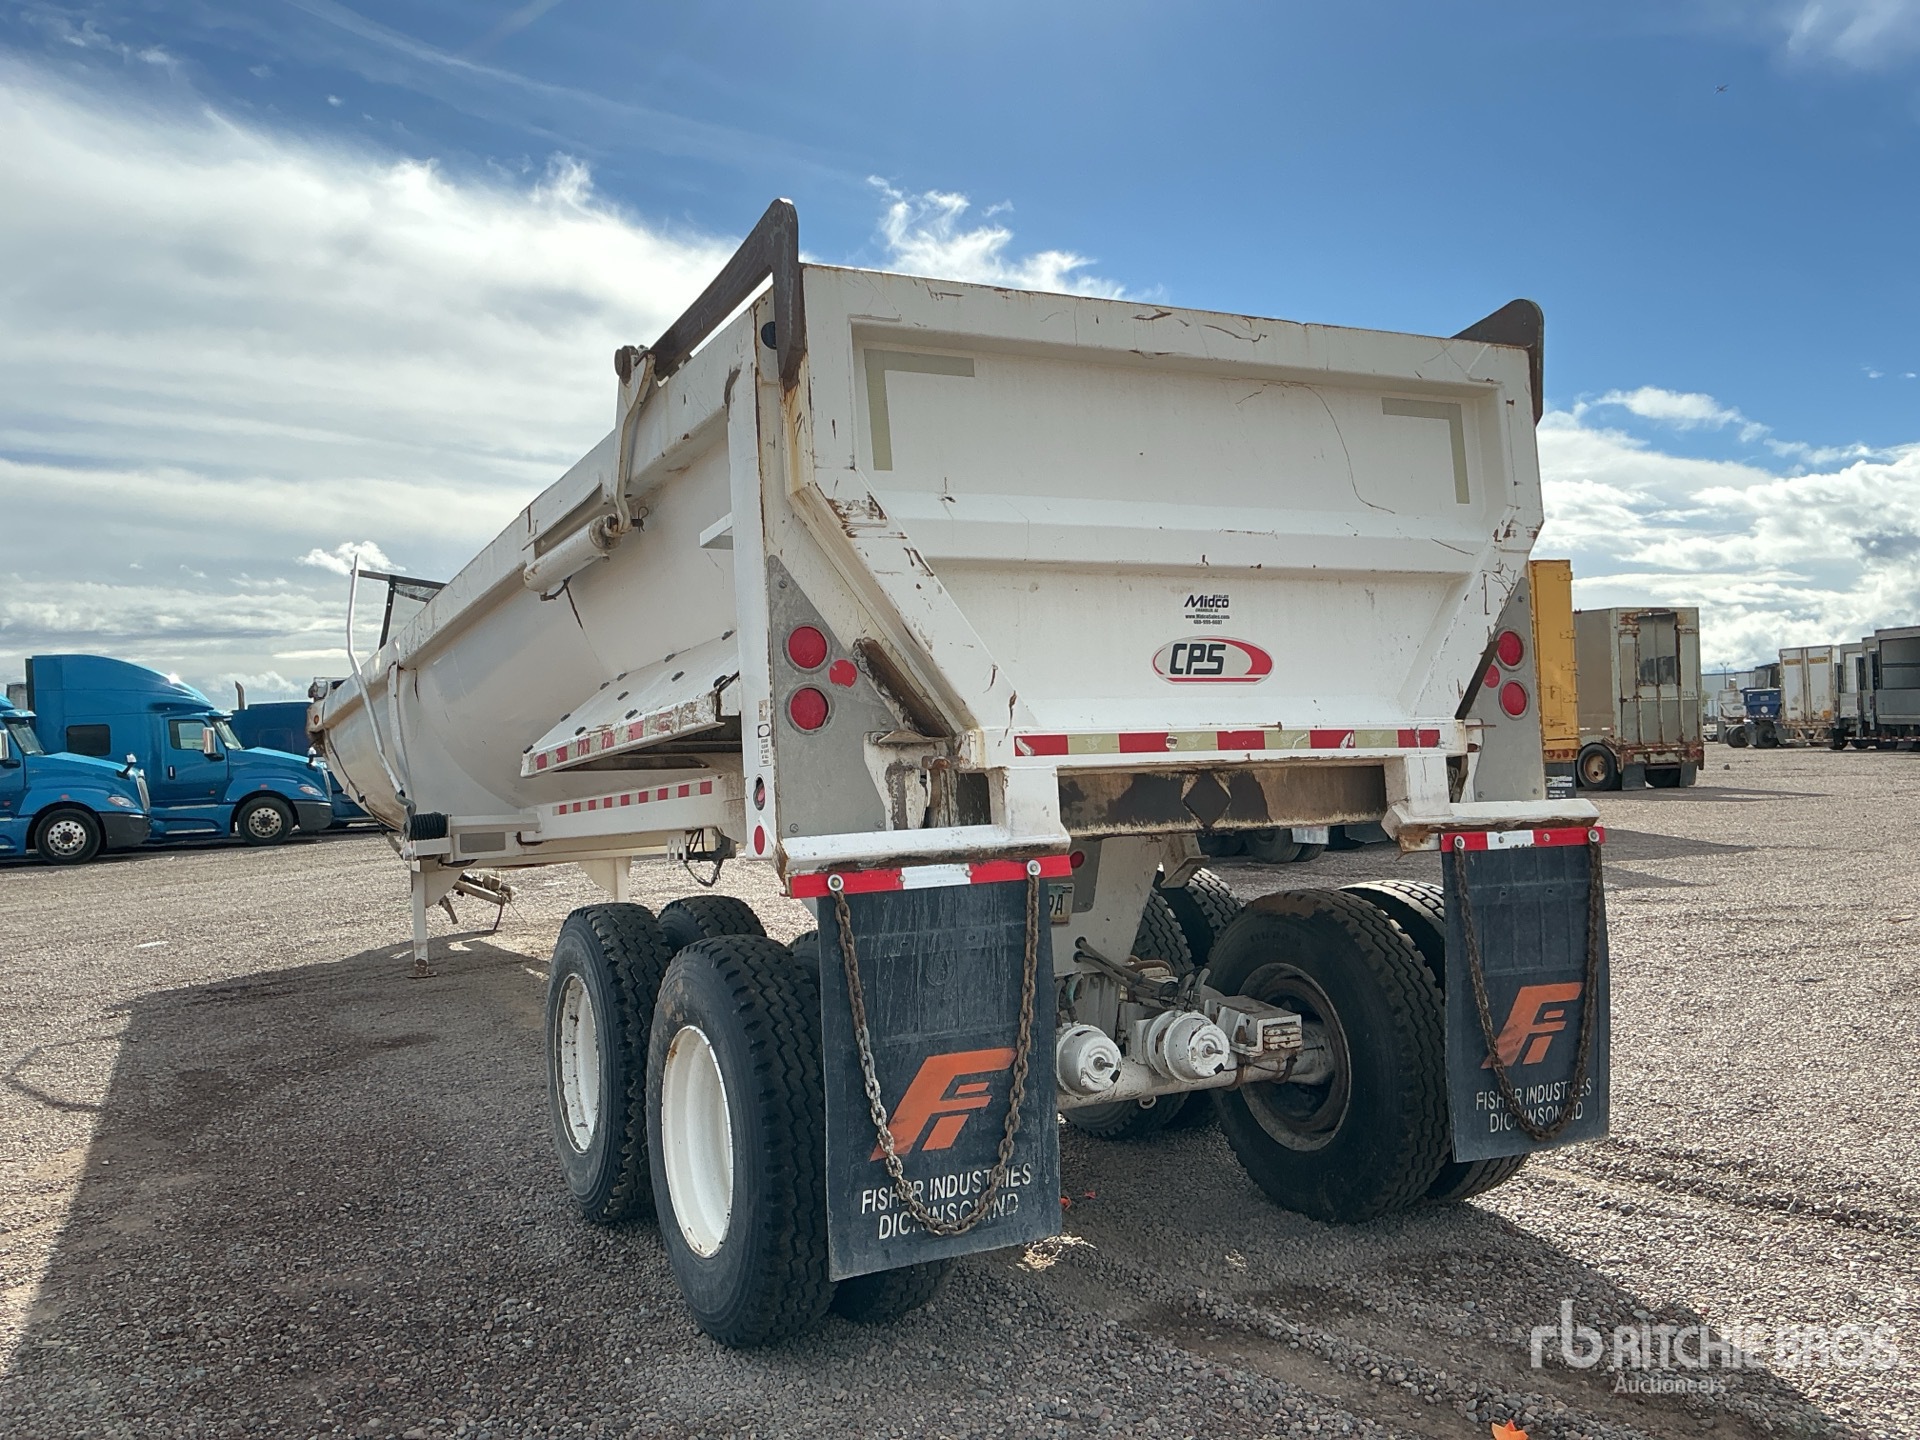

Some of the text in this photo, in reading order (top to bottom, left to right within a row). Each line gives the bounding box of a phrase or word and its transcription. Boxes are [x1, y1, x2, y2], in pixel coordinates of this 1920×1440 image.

[1184, 594, 1229, 608] Midco
[1169, 643, 1226, 675] CPS
[1476, 1077, 1592, 1111] FISHR INDUSTS
[861, 1162, 1031, 1214] FISHR INDUSTIES
